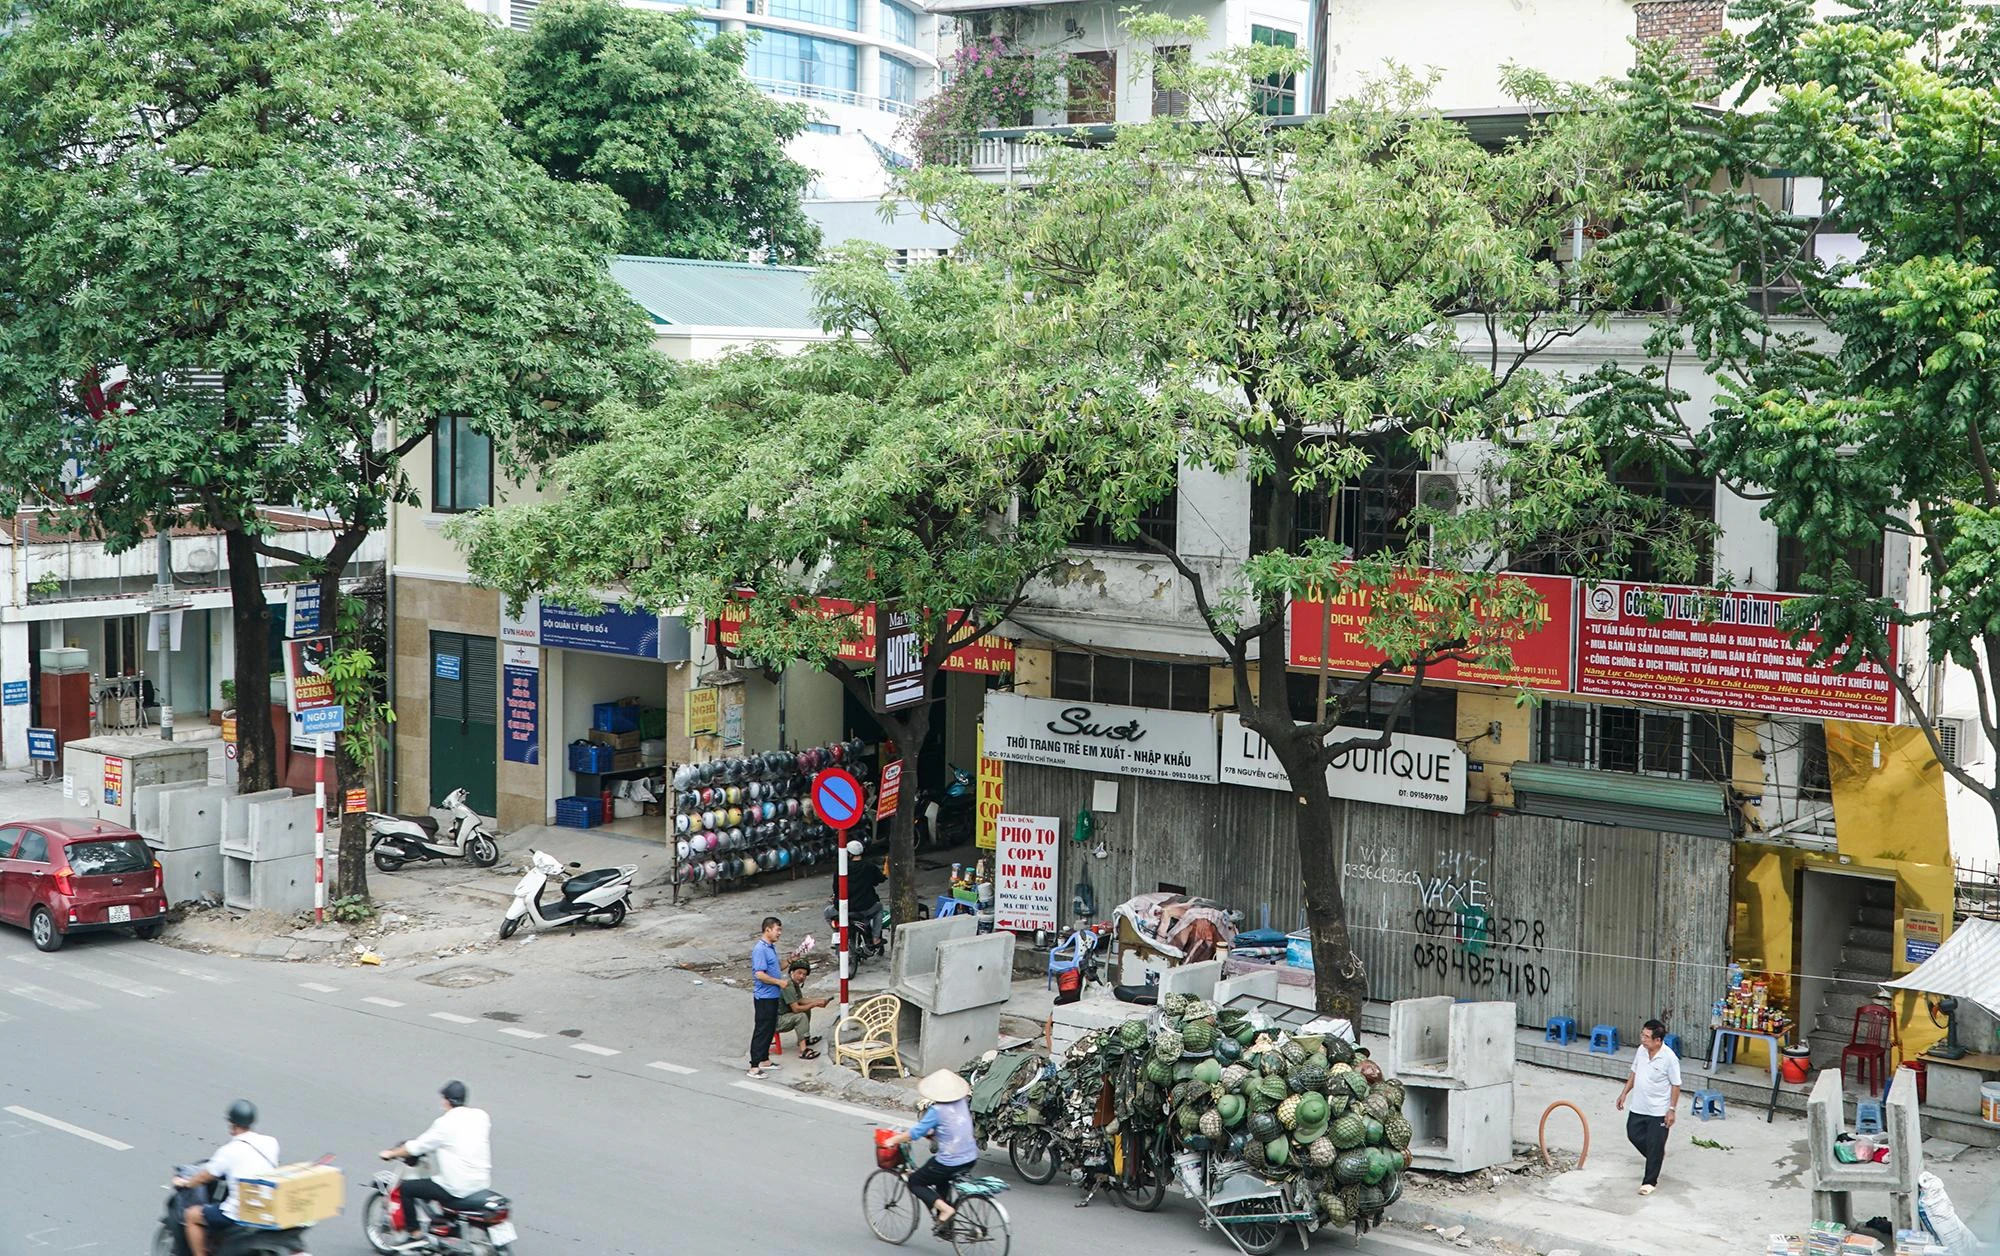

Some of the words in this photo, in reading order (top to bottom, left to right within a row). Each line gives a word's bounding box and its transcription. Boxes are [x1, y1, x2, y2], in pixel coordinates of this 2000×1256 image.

[1739, 594, 1771, 627] BÌNH
[1331, 614, 1353, 626] DỊCH
[1602, 622, 1618, 635] VẤN
[1648, 626, 1660, 639] TÀI
[1690, 632, 1707, 643] MUA
[1710, 632, 1727, 645] BÁN
[1728, 635, 1735, 645] &
[1737, 635, 1756, 647] KHAI
[1757, 636, 1779, 650] THÁC
[1590, 639, 1606, 649] MUA
[1608, 639, 1623, 652] BÁN
[1625, 640, 1636, 652] TÀI
[1638, 640, 1653, 654] SẢN
[1654, 644, 1679, 656] DOANH
[1710, 650, 1727, 660] MUA
[1729, 649, 1745, 662] BÁN
[1746, 650, 1761, 663] BẤT
[1590, 653, 1610, 665] CÔNG
[1611, 655, 1636, 668] CHỨNG
[1638, 659, 1644, 668] &
[1646, 659, 1663, 671] DỊCH
[1701, 661, 1718, 675] VẤN
[1719, 664, 1740, 677] PHÁP
[1754, 669, 1779, 681] TRANH
[1781, 671, 1802, 684] TỤNG
[1822, 674, 1847, 687] QUYẾT
[1874, 680, 1888, 692] NẠI
[296, 686, 332, 699] GEISHA
[1668, 685, 1689, 693] Thanh
[328, 711, 338, 719] 97
[1006, 734, 1028, 749] THỜI
[1030, 739, 1060, 752] TRANG
[1063, 740, 1080, 754] TRẺ
[1083, 745, 1098, 757] EM
[1100, 744, 1125, 759] XUẤT
[1134, 750, 1161, 766] NHẬP
[1164, 750, 1191, 767] KHẨU
[1012, 753, 1034, 761] NGUYỄN
[1330, 748, 1450, 783] OUTIQUE
[1237, 768, 1266, 778] NGUYỄN
[1410, 790, 1448, 802] 0915897889
[1001, 827, 1032, 843] PHO
[1036, 829, 1055, 845] TO
[1008, 848, 1046, 861] COPY
[1002, 864, 1016, 876] IN
[1021, 864, 1052, 879] MÀU
[1004, 880, 1018, 889] A4
